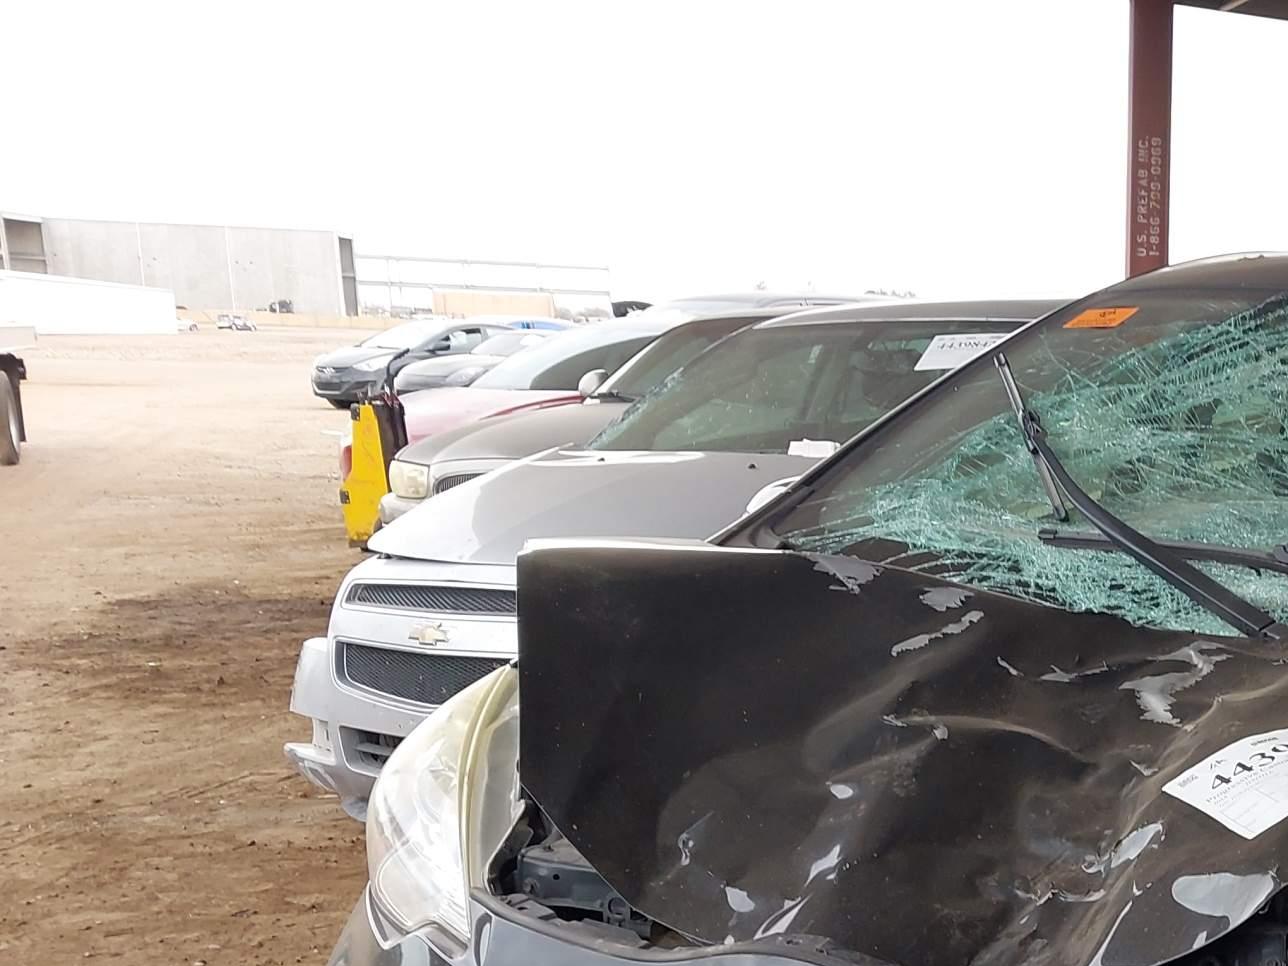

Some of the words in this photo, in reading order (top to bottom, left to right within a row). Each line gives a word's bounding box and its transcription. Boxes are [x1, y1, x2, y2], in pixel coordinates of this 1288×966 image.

[1136, 169, 1149, 223] PREFAB
[1149, 136, 1162, 256] 1-866-799-0969
[1136, 229, 1148, 257] U.S.
